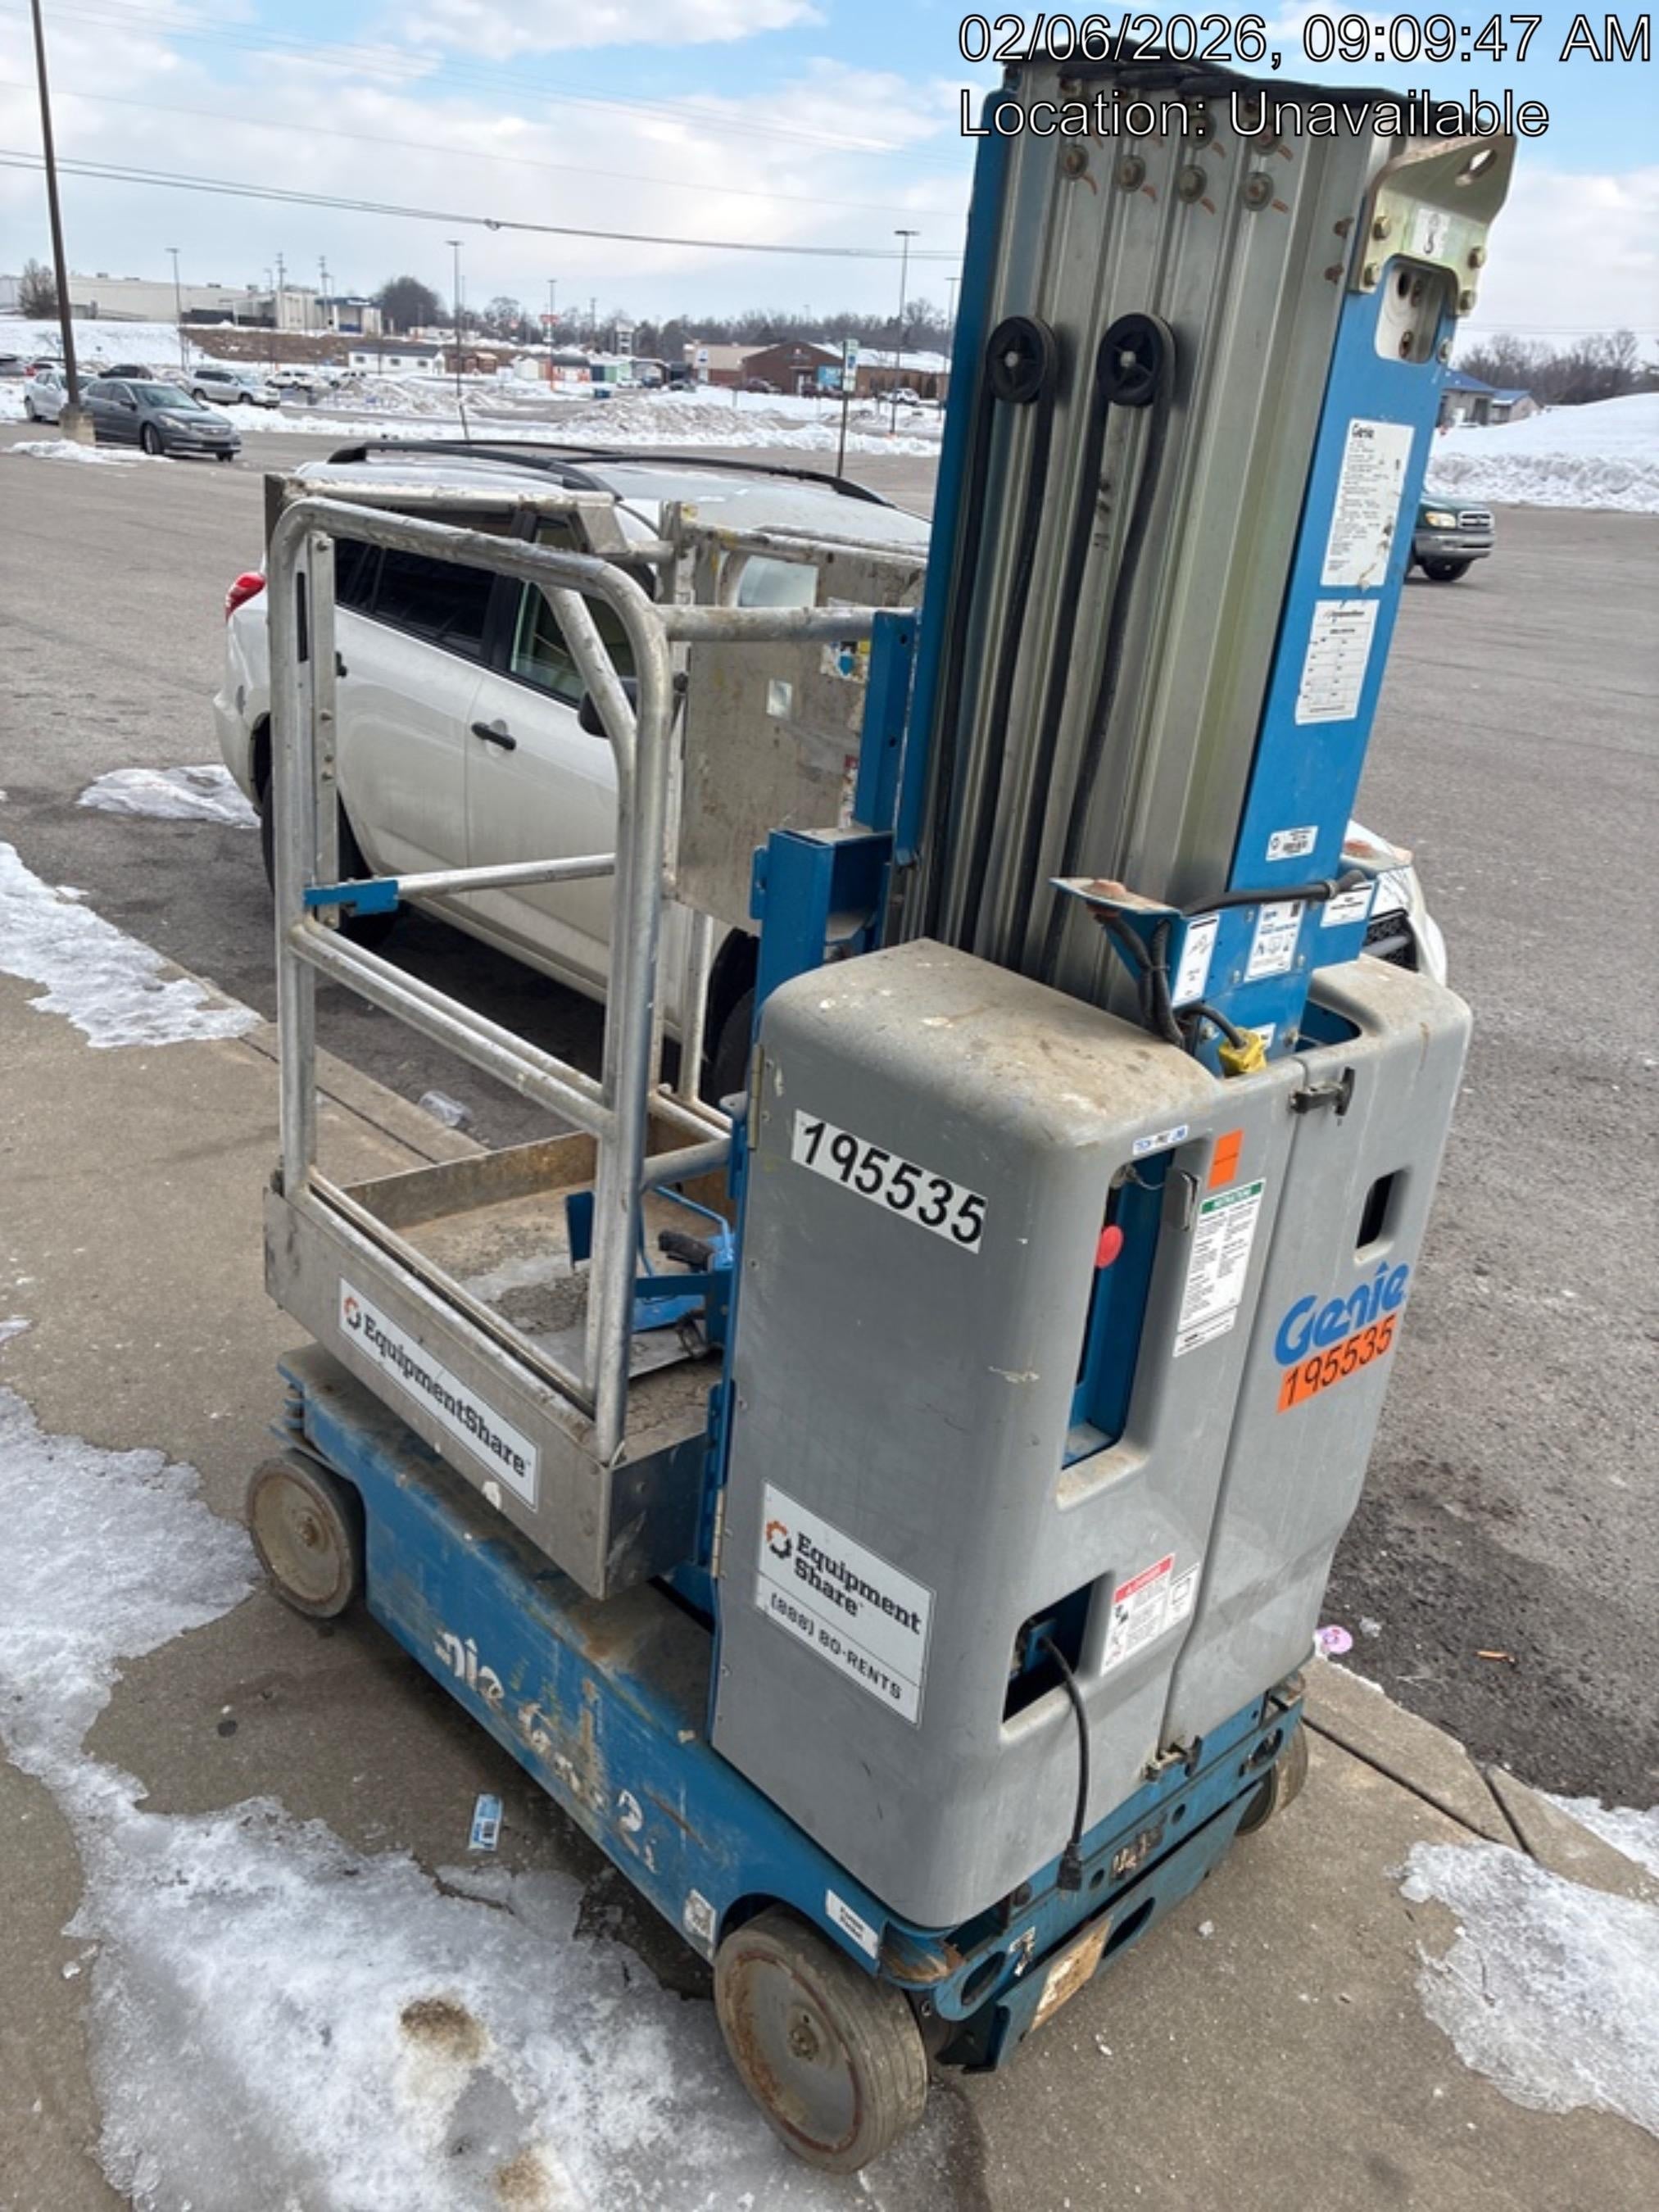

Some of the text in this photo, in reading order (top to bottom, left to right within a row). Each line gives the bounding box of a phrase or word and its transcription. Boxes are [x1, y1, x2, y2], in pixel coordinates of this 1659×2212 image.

[804, 1122, 986, 1244] 195535
[1275, 1262, 1409, 1367] Genie
[1285, 1313, 1396, 1405] 195535
[364, 1314, 525, 1478] EquipmentShare
[795, 1557, 859, 1617] Share
[796, 1532, 922, 1634] Equipment
[771, 1593, 902, 1699] (888) 80-RENTS
